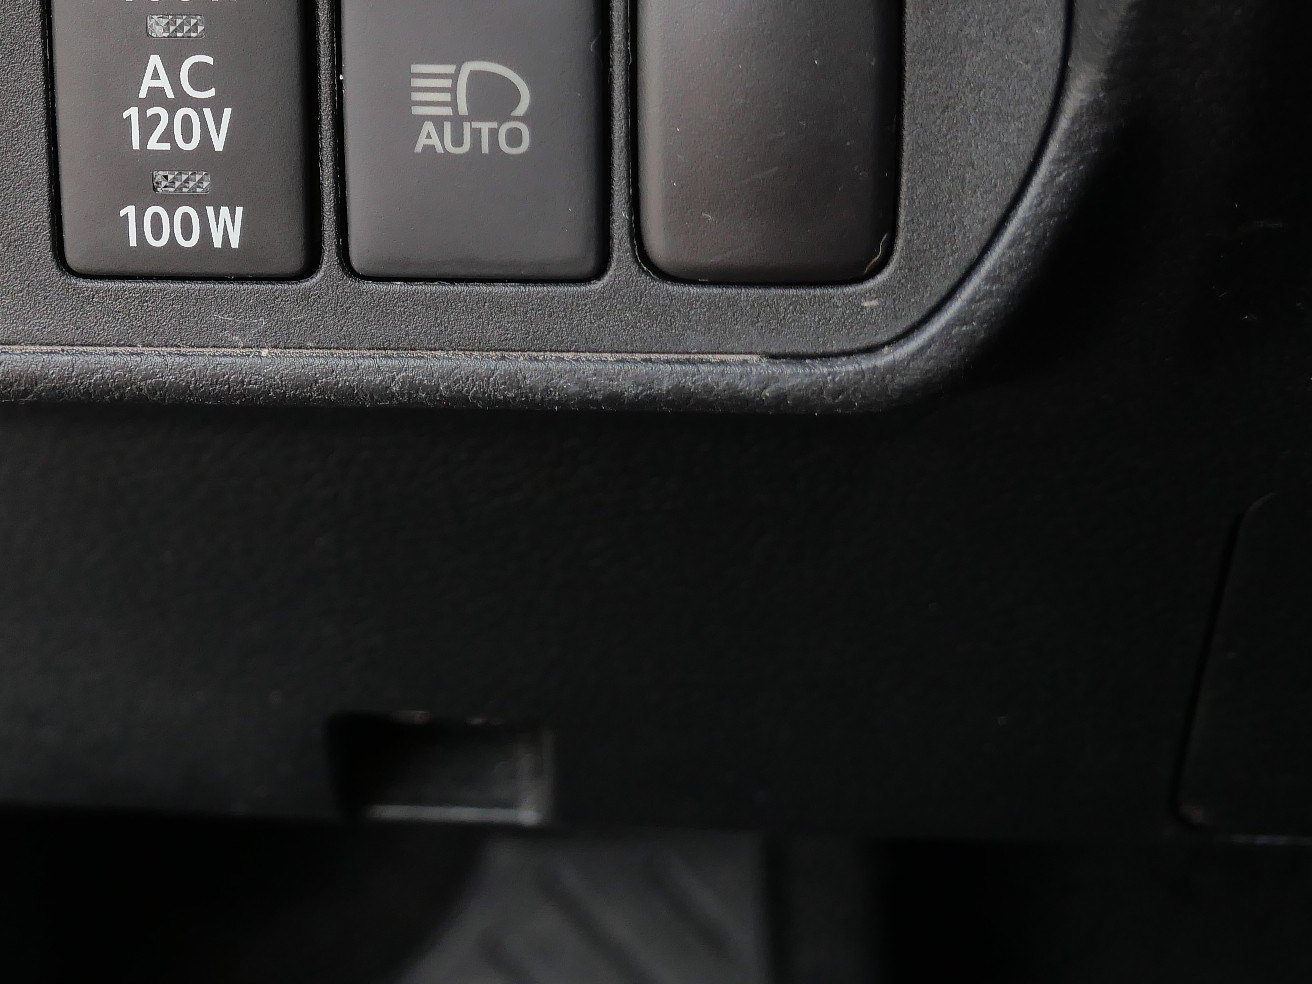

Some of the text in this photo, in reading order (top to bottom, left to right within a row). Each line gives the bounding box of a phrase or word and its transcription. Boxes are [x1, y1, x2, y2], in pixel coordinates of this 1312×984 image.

[137, 53, 217, 100] AC
[121, 105, 234, 153] 120V
[413, 119, 531, 156] AUTO
[118, 203, 245, 250] 100W
